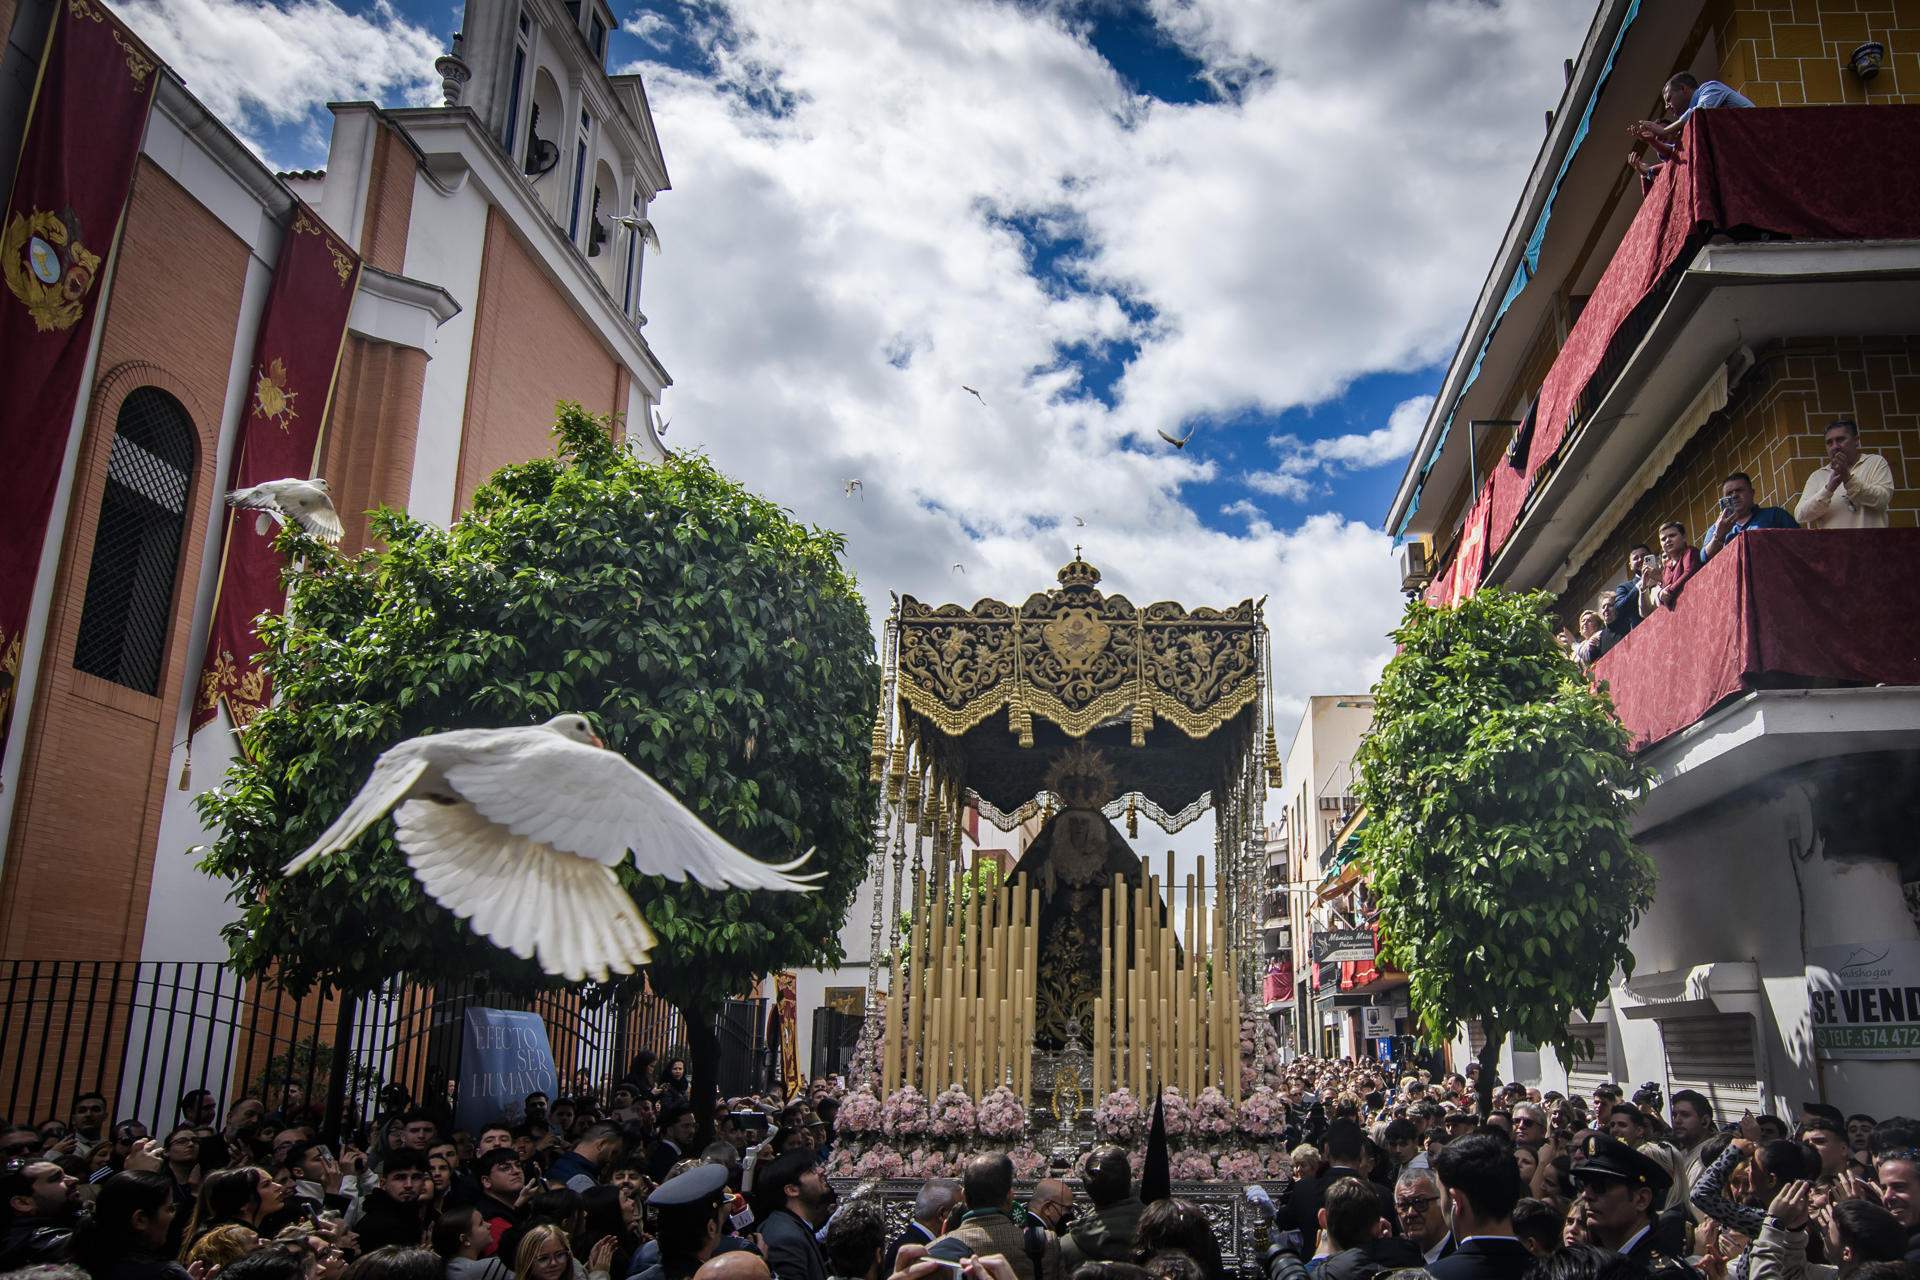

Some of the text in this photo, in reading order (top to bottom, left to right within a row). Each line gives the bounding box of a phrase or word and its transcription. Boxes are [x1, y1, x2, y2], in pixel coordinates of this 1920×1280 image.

[1811, 987, 1920, 1024] SE VEND
[474, 1025, 538, 1050] EFECTO
[1892, 1028, 1920, 1045] 472
[517, 1049, 548, 1071] SER
[472, 1070, 551, 1097] HUMANO
